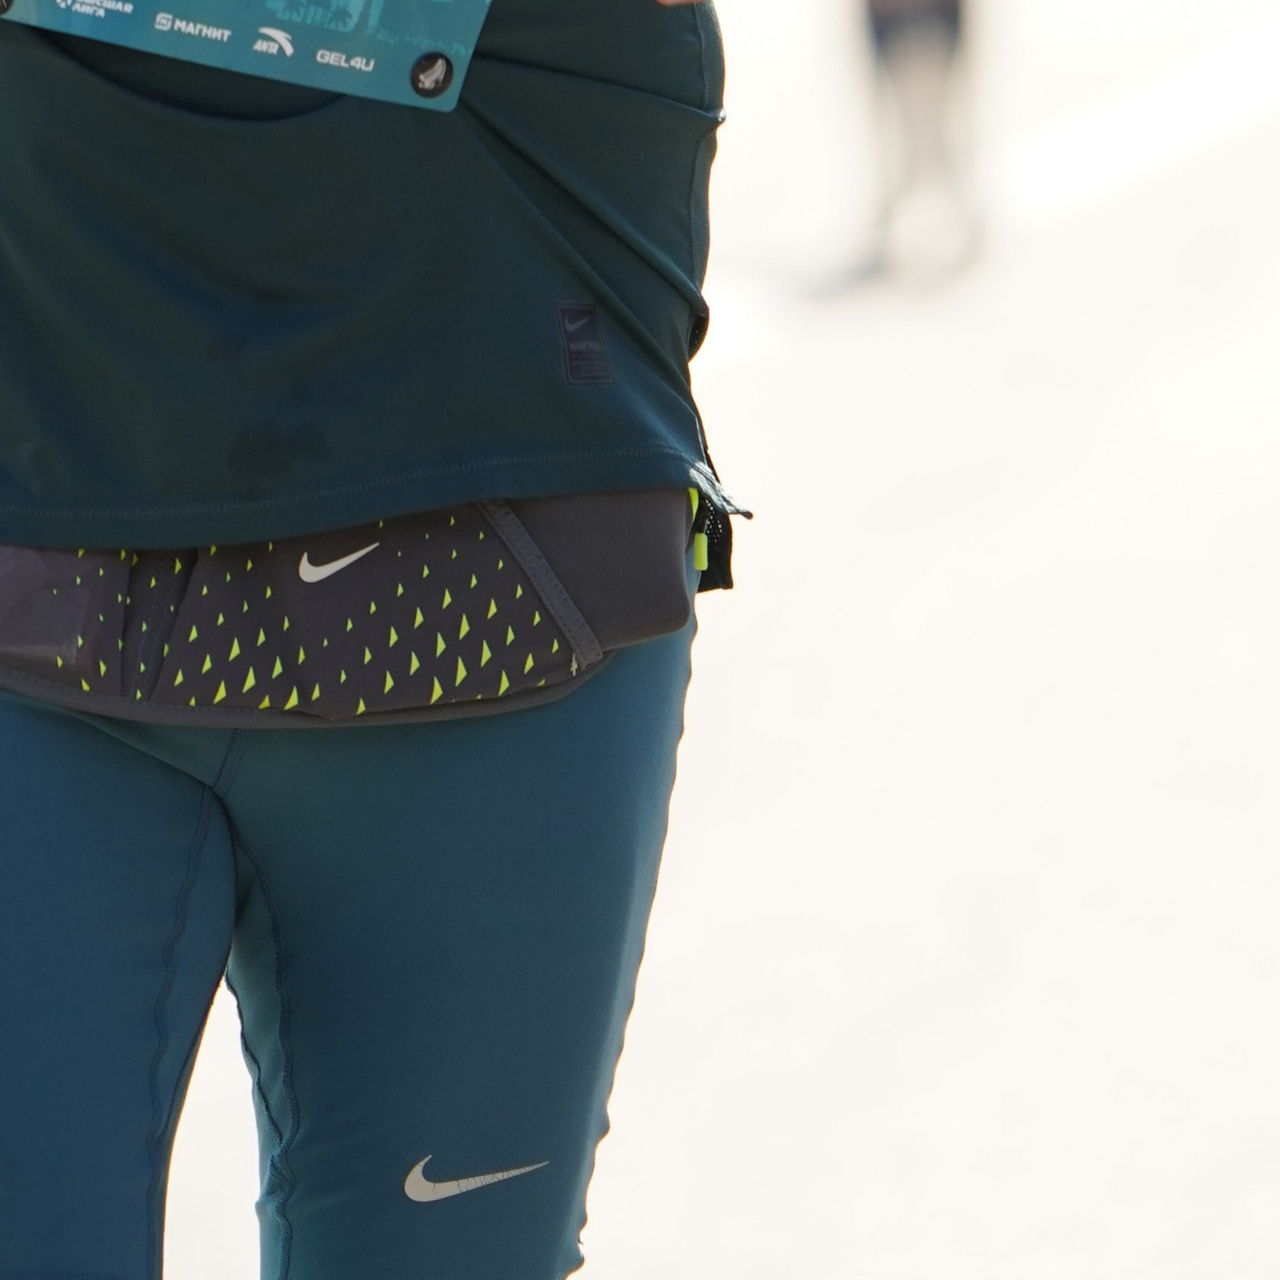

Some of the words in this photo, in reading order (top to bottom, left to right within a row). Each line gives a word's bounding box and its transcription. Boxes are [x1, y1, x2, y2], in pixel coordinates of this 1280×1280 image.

[71, 1, 106, 19] ЛИГА
[173, 18, 232, 43] МАГНИТ
[316, 48, 375, 73] GEL4U
